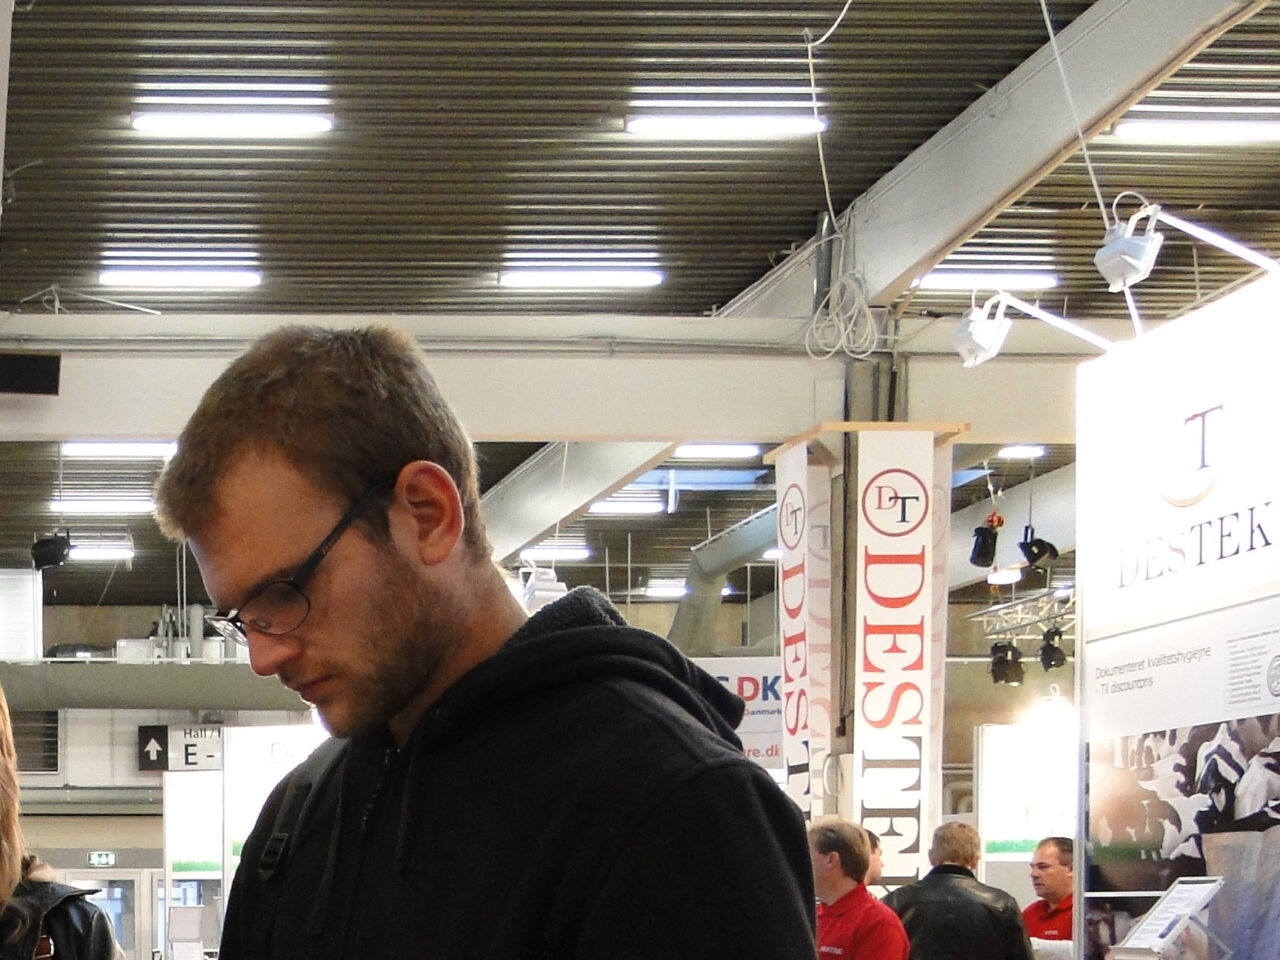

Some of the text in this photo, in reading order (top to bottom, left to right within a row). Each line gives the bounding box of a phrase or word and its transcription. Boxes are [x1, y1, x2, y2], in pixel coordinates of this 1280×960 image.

[1118, 501, 1273, 588] DESTEK
[781, 553, 812, 824] DEST
[183, 727, 207, 739] Hall
[184, 743, 198, 766] E
